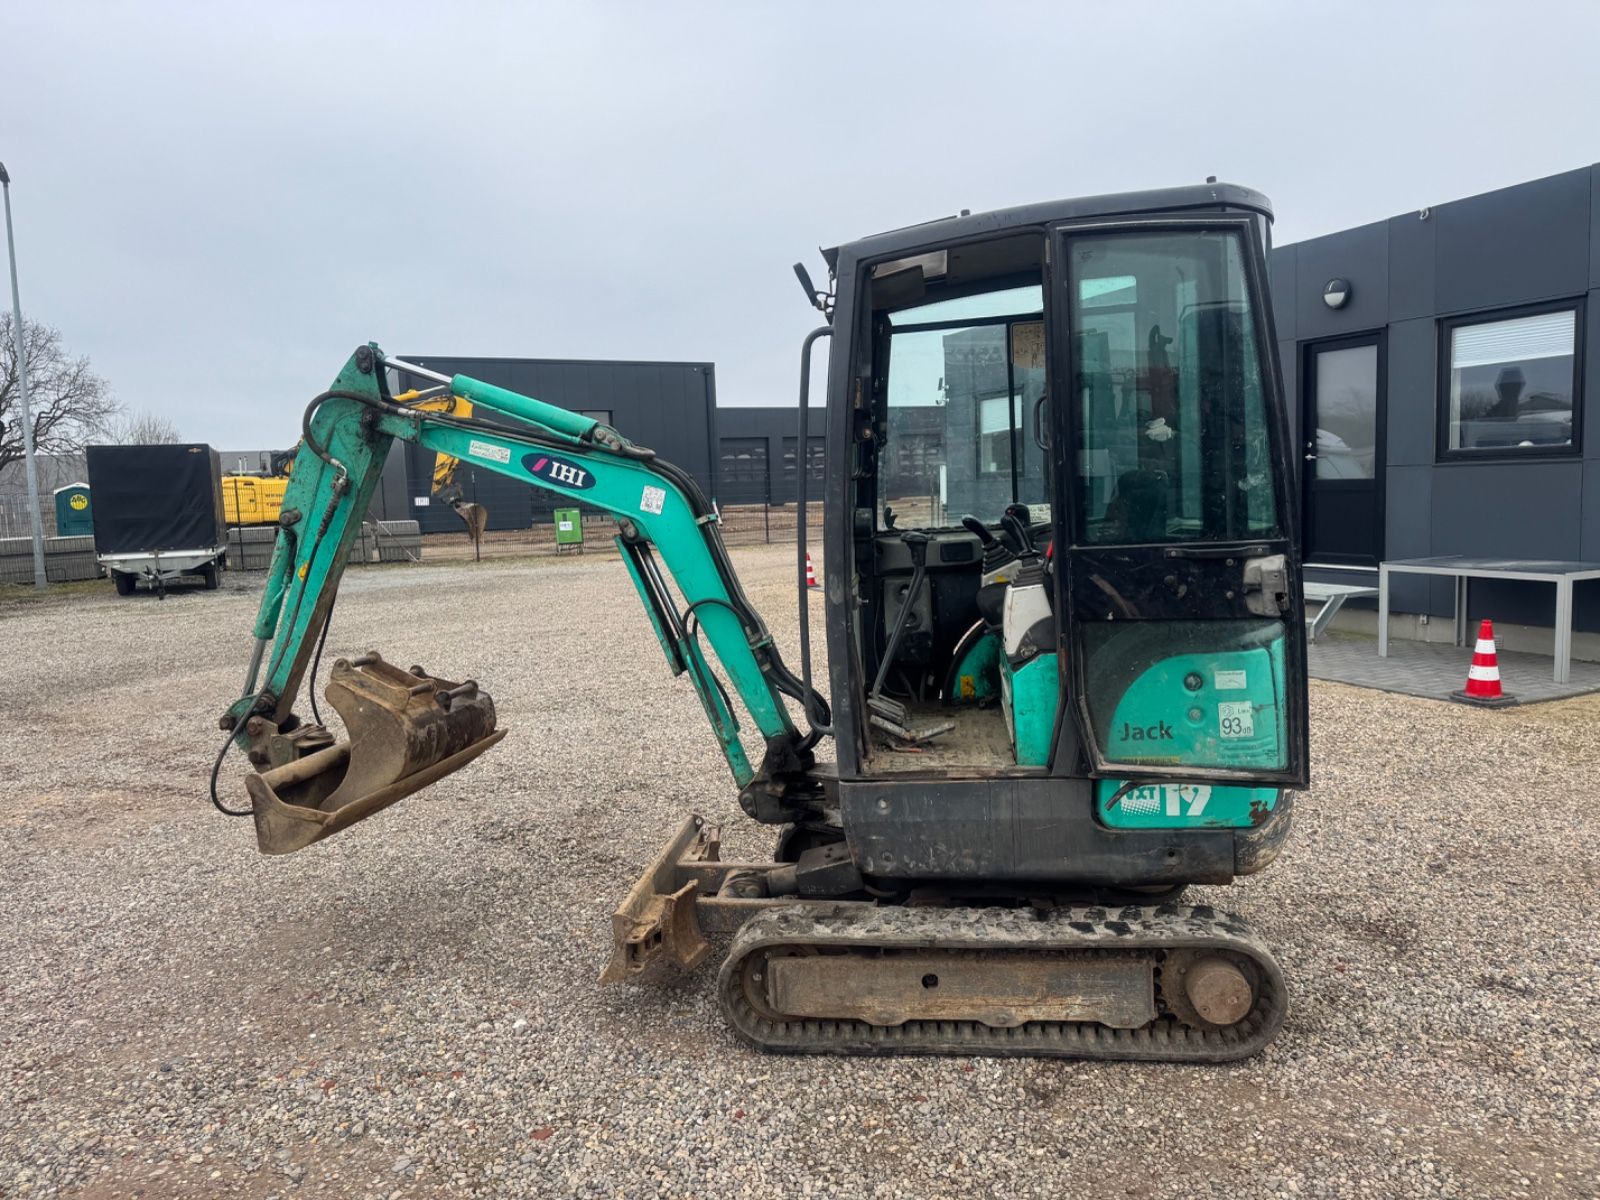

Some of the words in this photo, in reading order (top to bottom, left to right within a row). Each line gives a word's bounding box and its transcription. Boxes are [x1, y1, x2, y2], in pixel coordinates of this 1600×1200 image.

[549, 461, 586, 487] IHI
[1120, 719, 1174, 741] Jack
[1222, 717, 1242, 735] 93
[1161, 783, 1212, 816] 19
